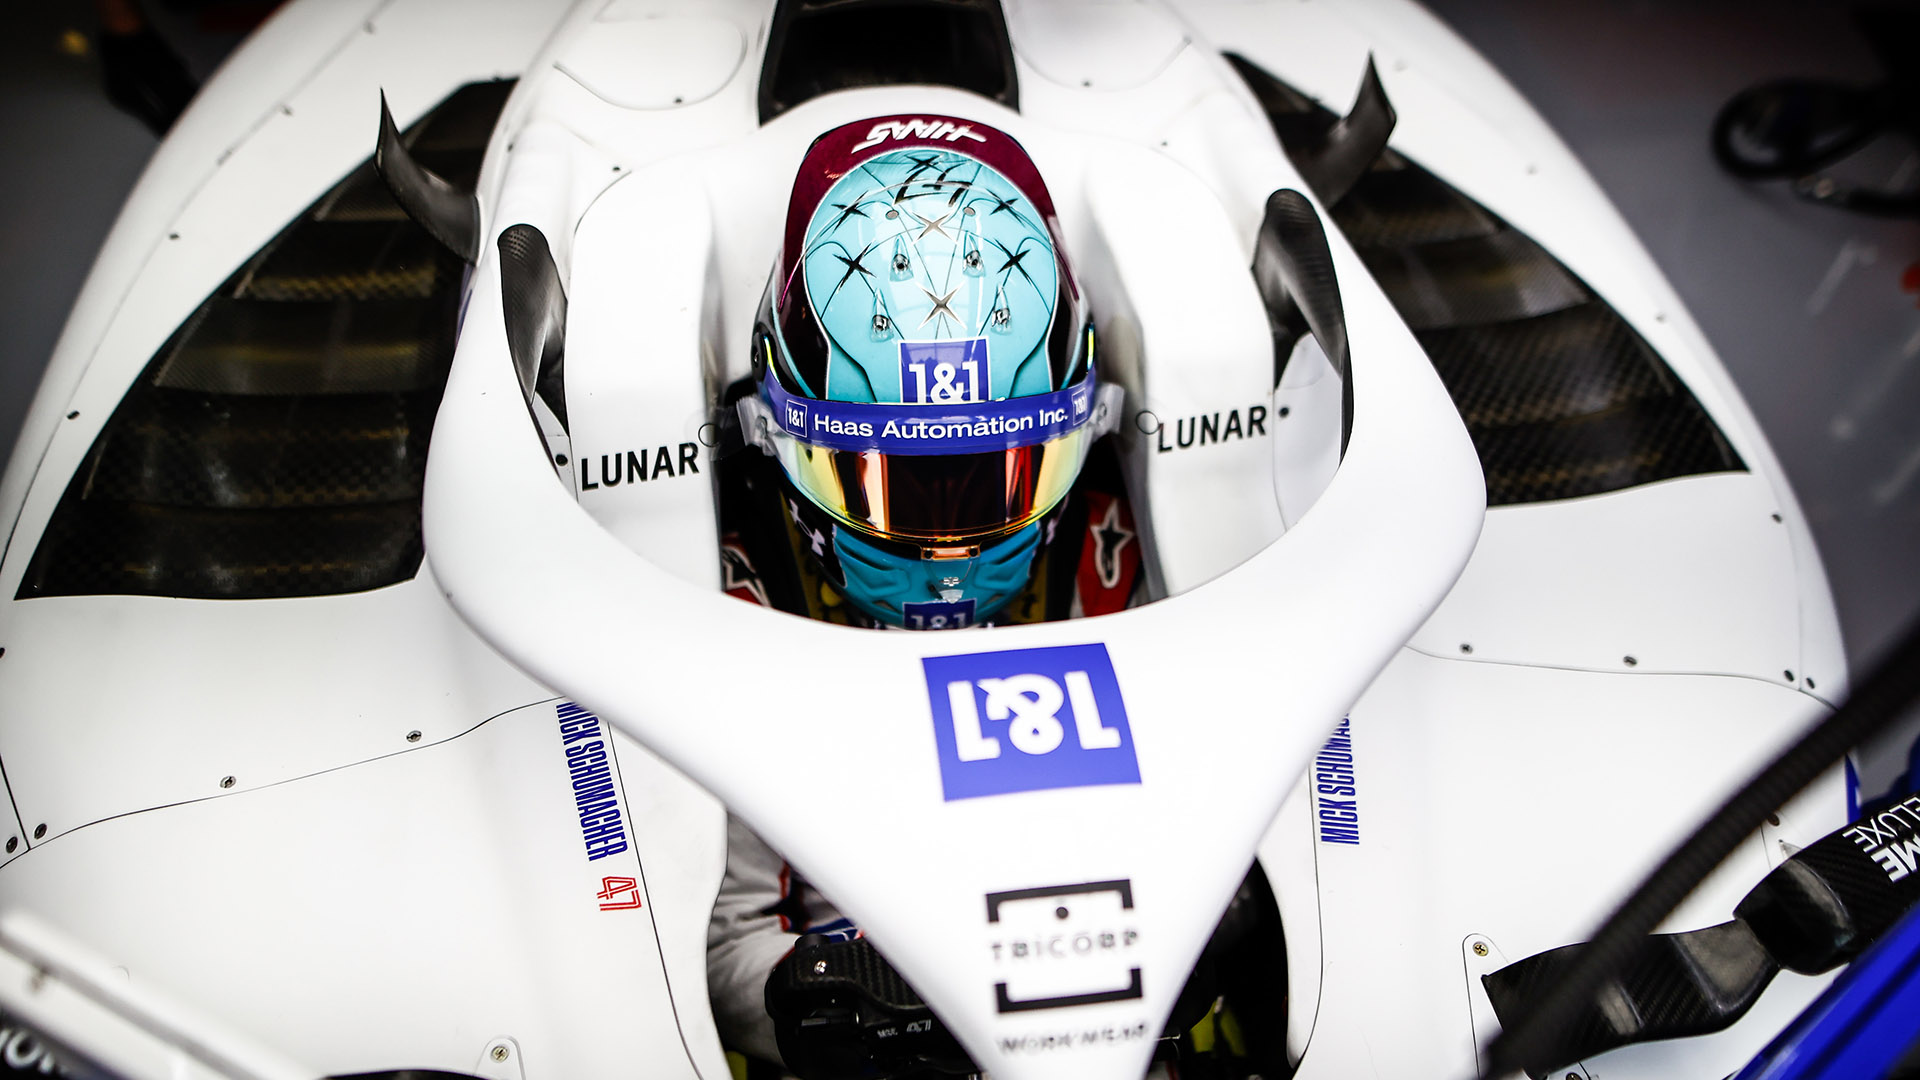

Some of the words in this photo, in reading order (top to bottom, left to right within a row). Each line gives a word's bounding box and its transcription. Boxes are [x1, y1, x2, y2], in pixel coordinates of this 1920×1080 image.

[909, 360, 982, 403] 1&1
[787, 406, 805, 429] 1&1
[813, 414, 874, 437] Haas
[881, 415, 1033, 440] Automation
[1039, 406, 1069, 427] Inc.
[1158, 405, 1266, 453] LUNAR
[580, 442, 700, 491] LUNAR
[947, 670, 1122, 762] 1&1
[565, 740, 628, 861] SCHUMACHER
[597, 876, 642, 911] 47
[1318, 797, 1360, 845] MICK
